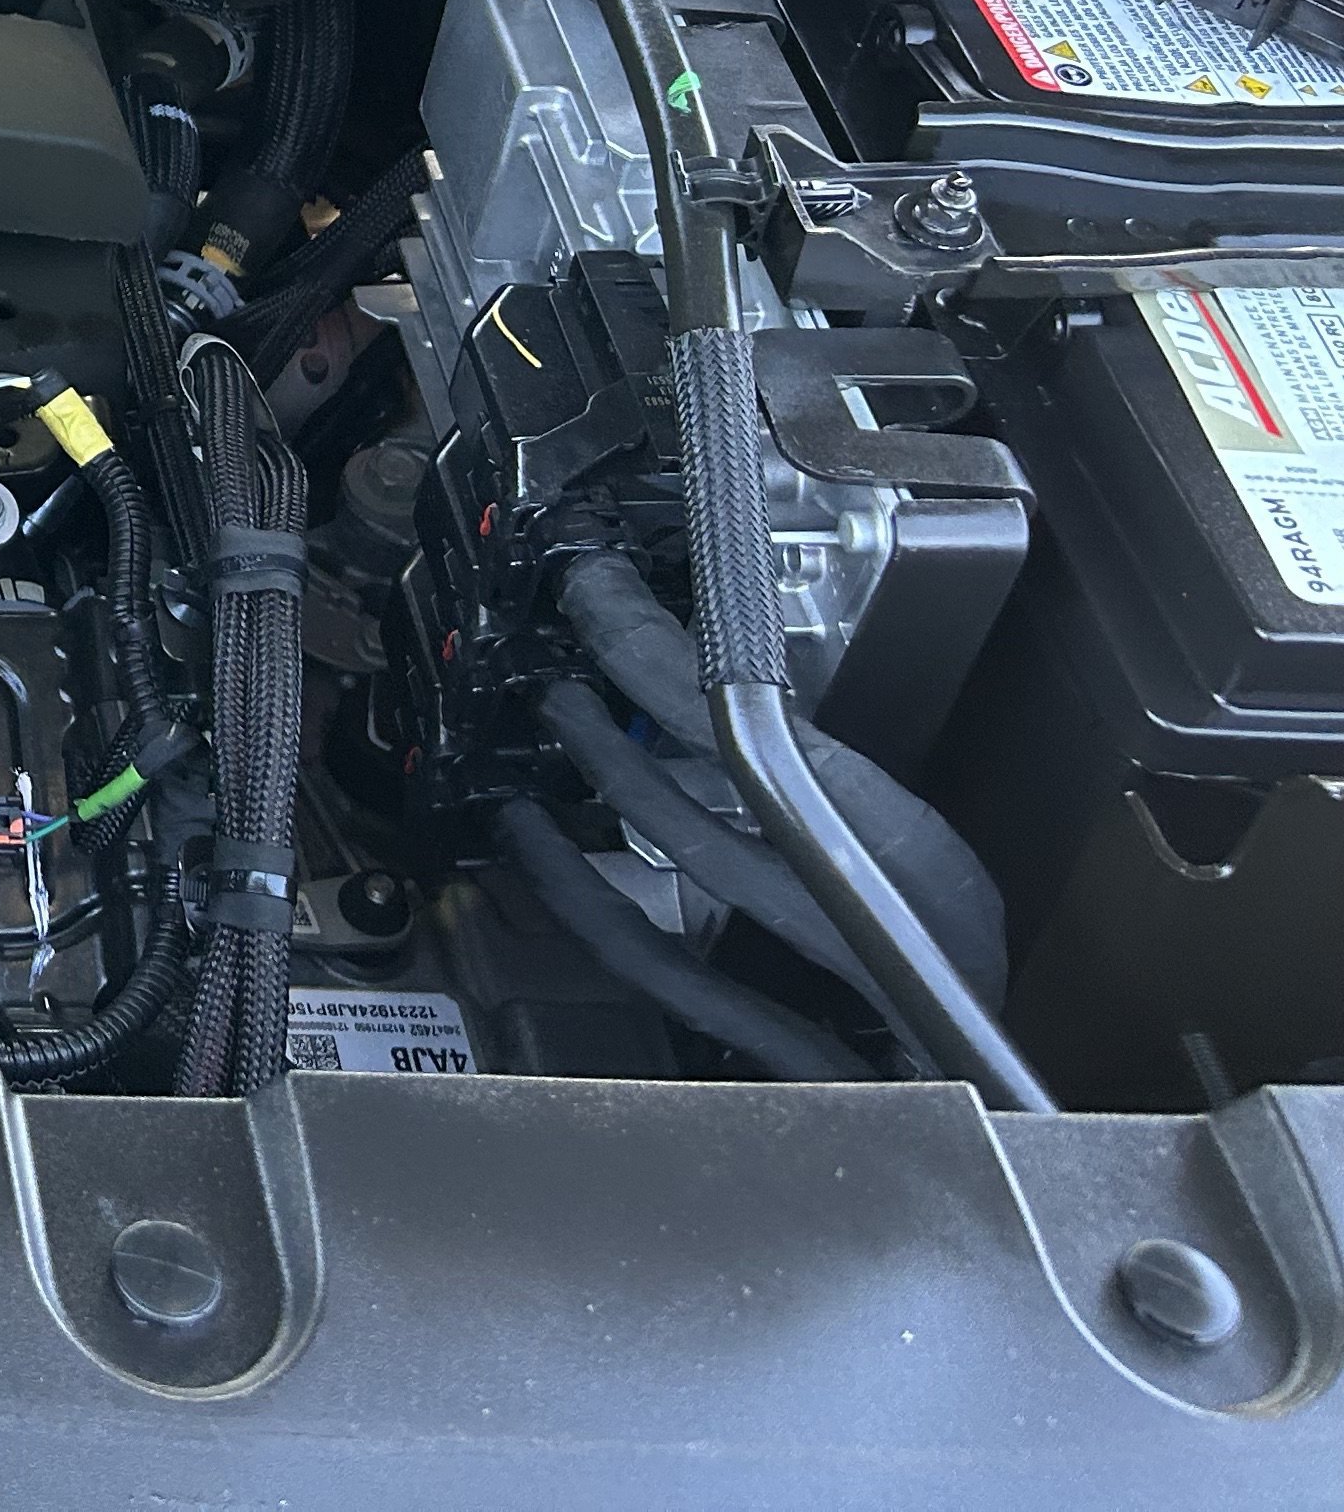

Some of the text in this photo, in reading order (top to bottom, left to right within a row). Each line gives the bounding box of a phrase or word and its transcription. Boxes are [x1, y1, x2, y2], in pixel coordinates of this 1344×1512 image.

[1244, 305, 1310, 403] MAINTENANCE
[1261, 497, 1335, 593] 94RAGM
[390, 1046, 468, 1073] 4AJB
